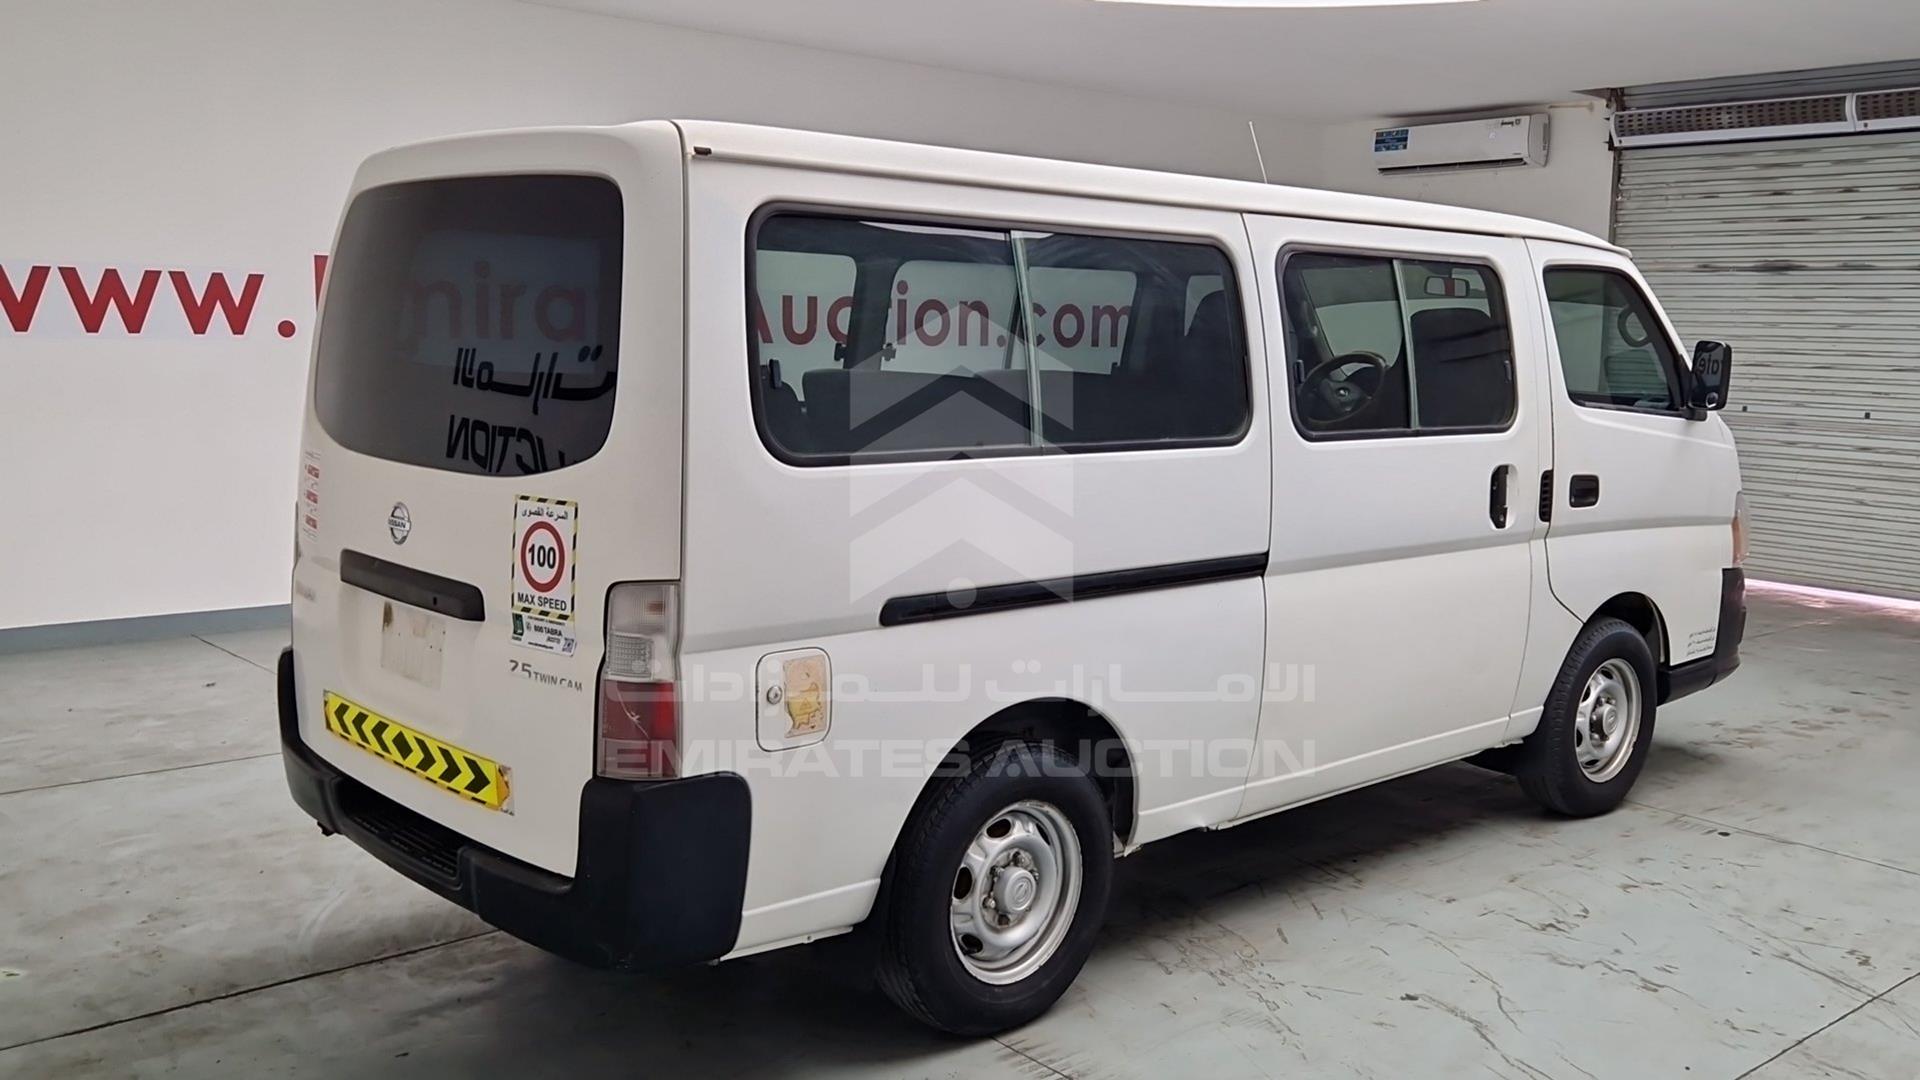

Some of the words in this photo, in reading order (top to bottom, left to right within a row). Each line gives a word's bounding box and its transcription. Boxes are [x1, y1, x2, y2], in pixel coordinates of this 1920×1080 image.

[528, 543, 557, 569] 100
[517, 591, 536, 606] MAX
[537, 595, 567, 611] SPEED
